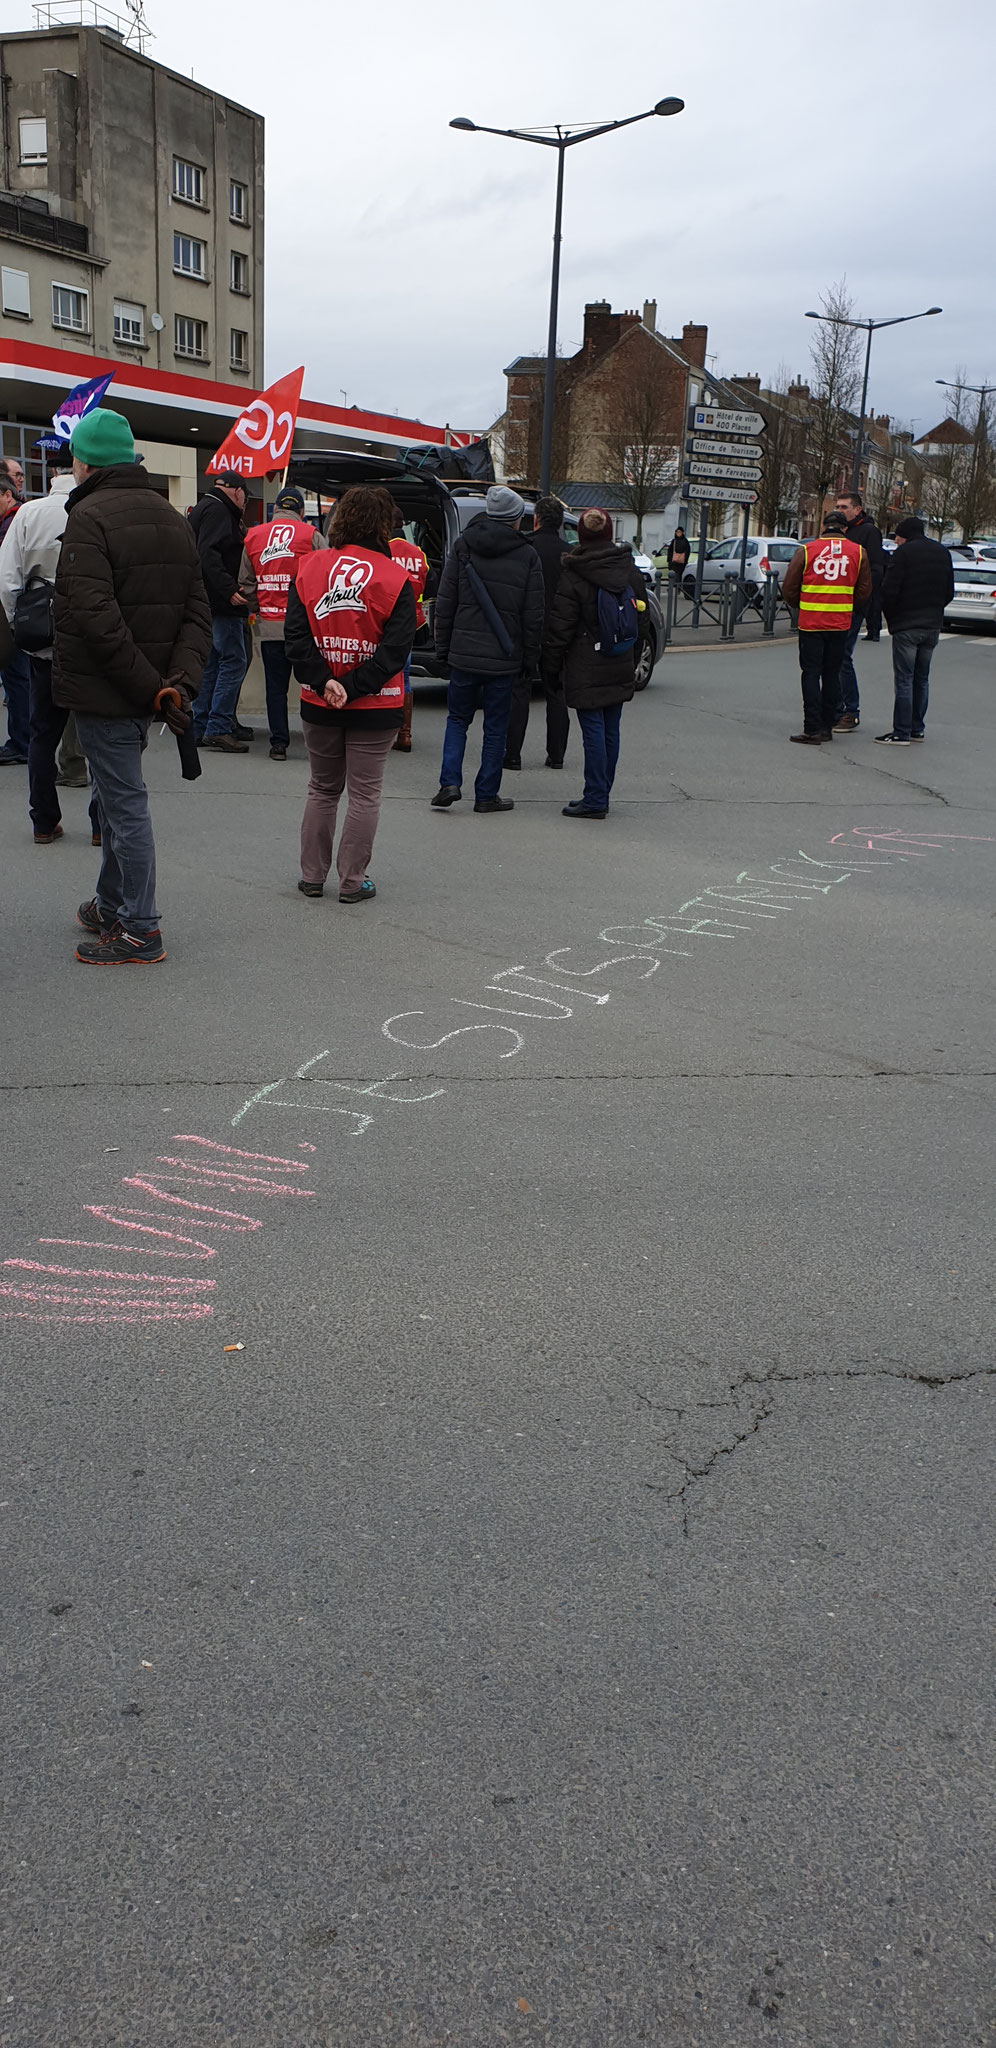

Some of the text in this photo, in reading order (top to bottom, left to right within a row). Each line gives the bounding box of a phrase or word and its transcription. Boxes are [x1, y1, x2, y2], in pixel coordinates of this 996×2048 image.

[716, 421, 752, 432] 400 Places
[744, 415, 758, 424] ville
[694, 441, 758, 456] Office de Tourisme
[692, 464, 758, 479] Palais de Fervaques
[691, 487, 712, 496] Palais
[268, 525, 294, 546] FO
[392, 556, 422, 572] NAF
[812, 555, 850, 581] cgt
[329, 556, 373, 591] FO
[342, 652, 355, 664] DE
